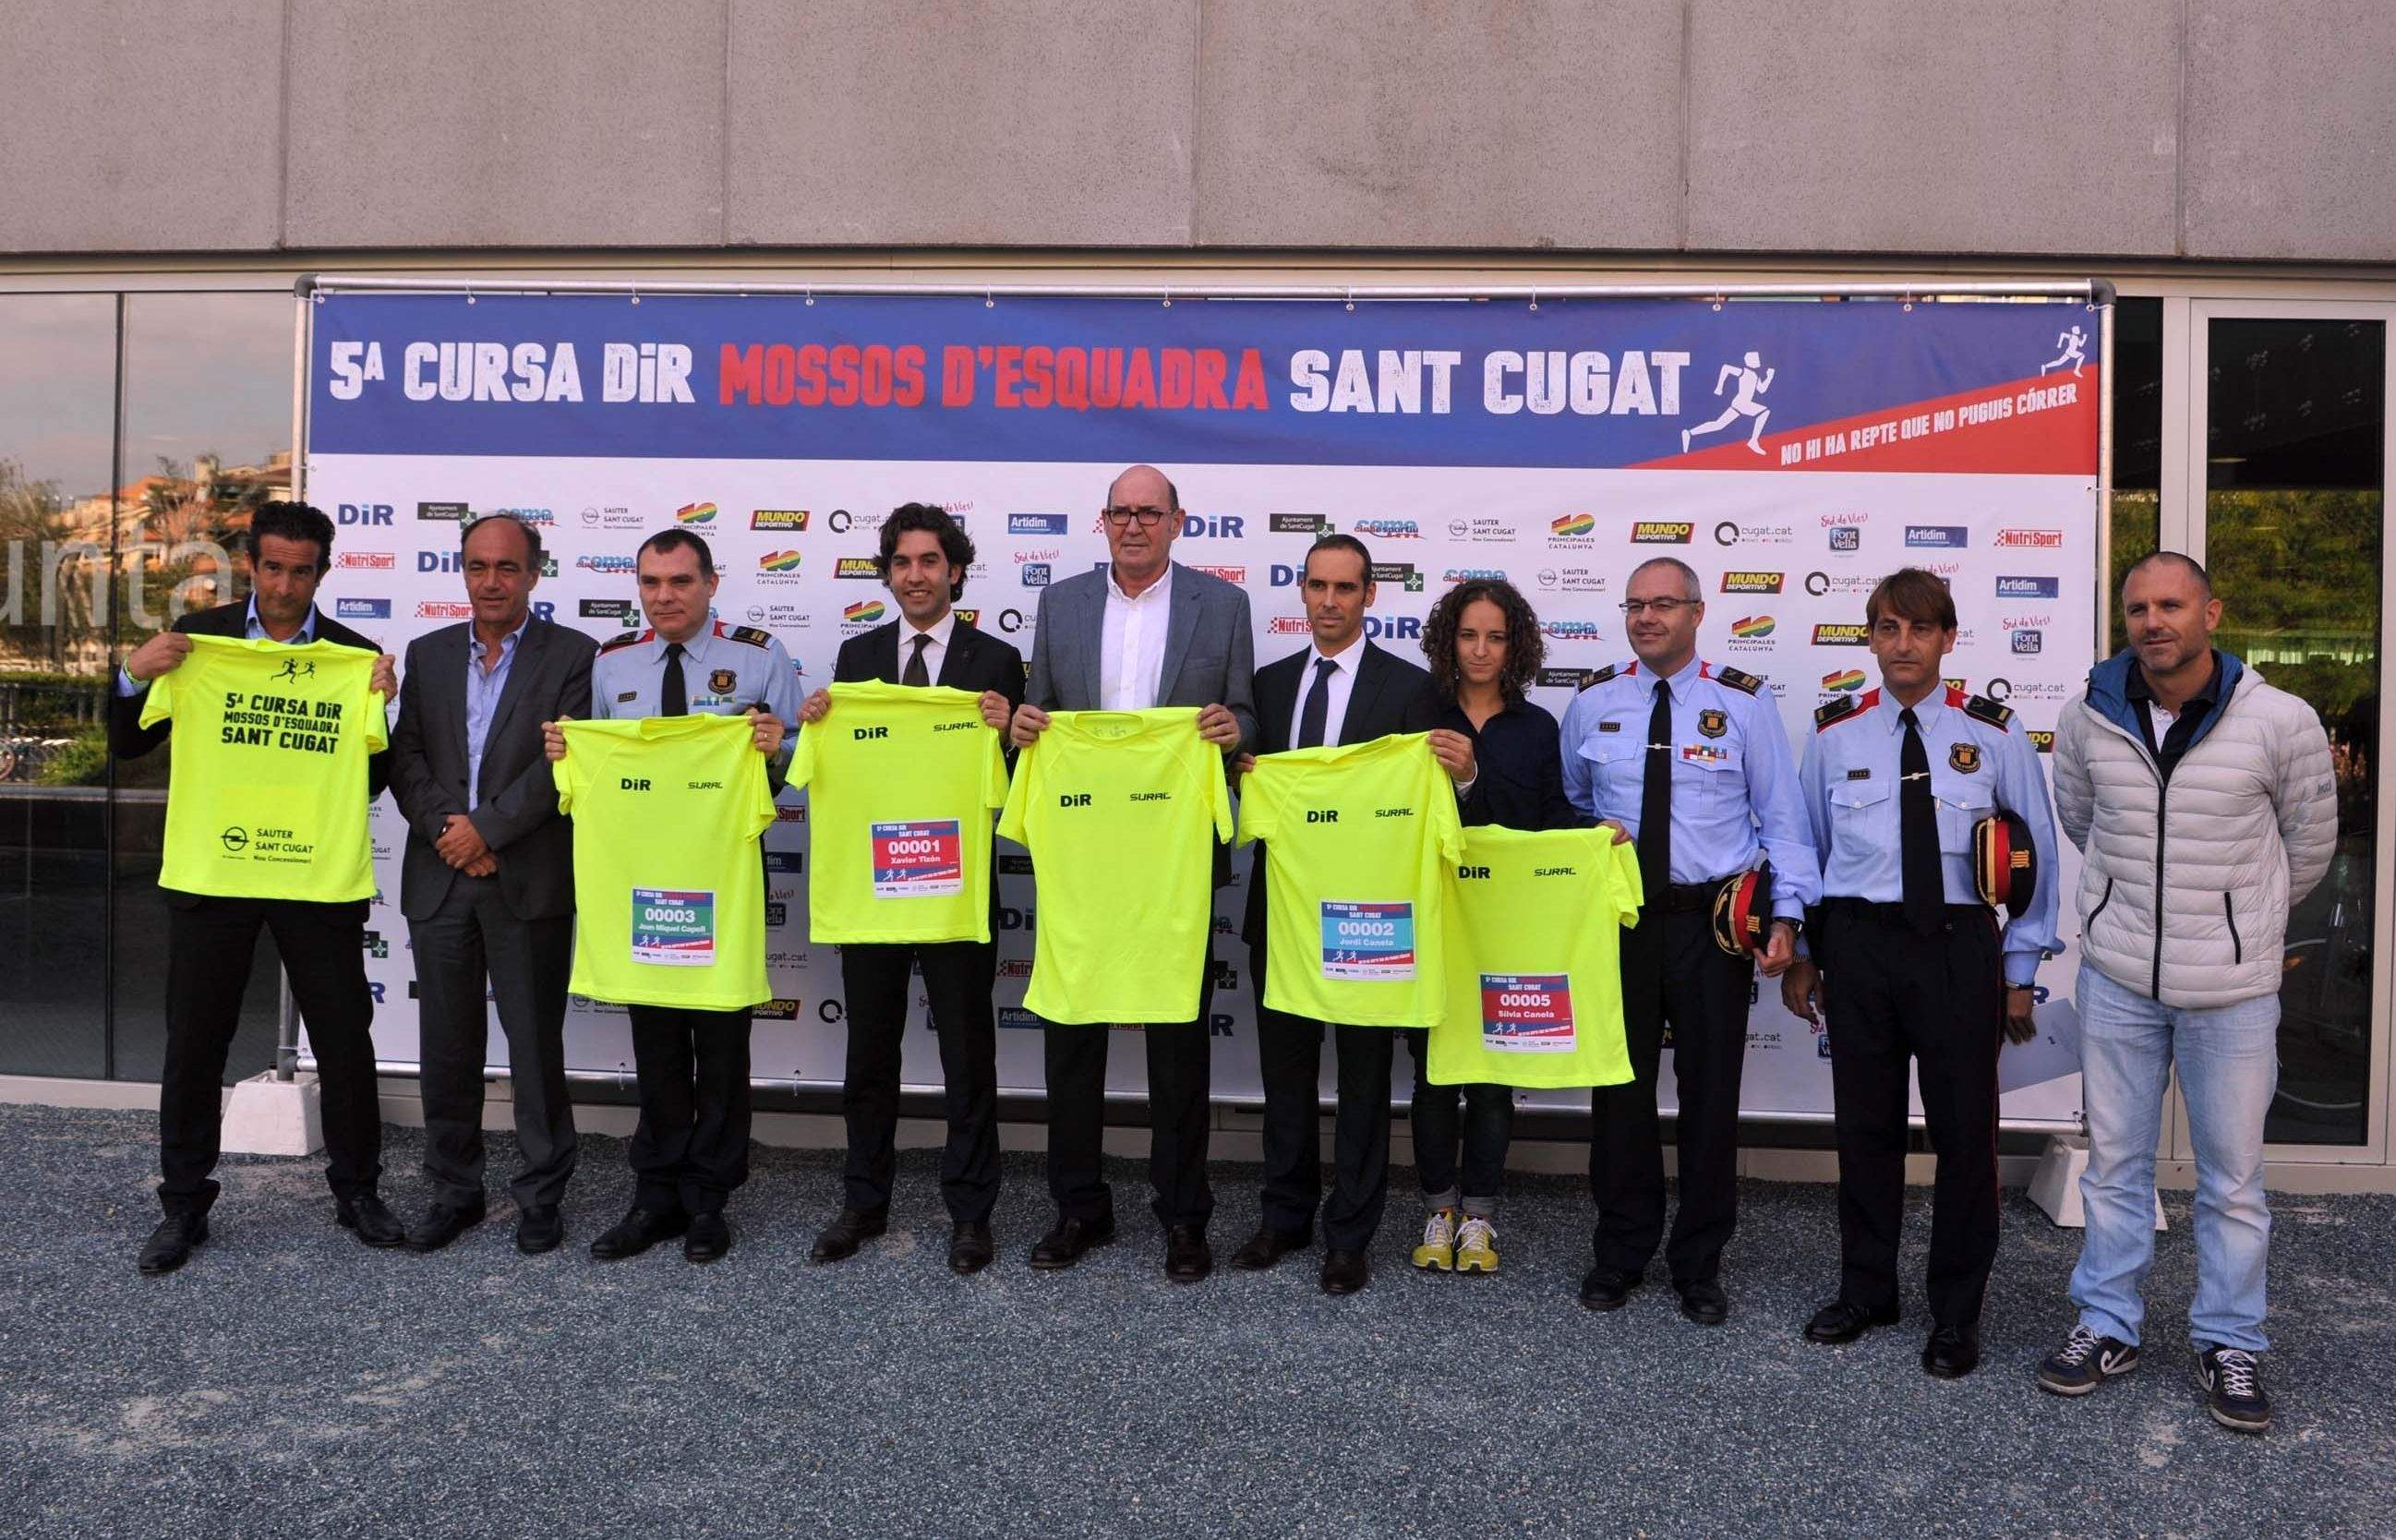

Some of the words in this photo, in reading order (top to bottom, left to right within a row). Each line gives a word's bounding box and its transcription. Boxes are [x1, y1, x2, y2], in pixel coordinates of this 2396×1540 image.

[403, 342, 584, 403] CURSA
[602, 343, 695, 403] DiR
[719, 343, 924, 406] MOSSOS
[942, 345, 1269, 413] D'ESQUADRA
[1290, 350, 1461, 414] SANT
[1484, 350, 1690, 415] CUGAT
[1781, 442, 1801, 465] NO
[1806, 438, 1821, 460] HI
[1825, 433, 1847, 456] HA
[1850, 422, 1896, 451] REPTE
[1901, 415, 1930, 439] QUE
[1934, 410, 1954, 432] NO
[1958, 398, 2012, 427] PUGUIS
[2017, 383, 2077, 414] CÓRRER
[338, 503, 393, 525] DiR
[756, 511, 805, 523] MUNDO
[1011, 517, 1047, 528] Artidim
[1183, 516, 1244, 537] DiR
[1638, 524, 1689, 535] MUNDO
[1741, 525, 1792, 536] cugat.cat
[1833, 530, 1856, 539] Font
[1908, 530, 1945, 541] Artidim
[1832, 539, 1857, 548] Vella
[1025, 565, 1048, 574] Font
[1270, 564, 1304, 586] Di
[1025, 575, 1048, 584] Vella
[1728, 573, 1779, 584] MUNDO
[1999, 580, 2037, 591] Artidim
[339, 600, 373, 612] Artidim
[2016, 632, 2039, 642] Font
[2015, 642, 2039, 652] Vella
[2014, 682, 2065, 694] cugat.cat
[250, 694, 308, 716] CURSA
[223, 711, 270, 727] MOSSOS
[273, 714, 340, 734] D'ESQUADRA
[853, 727, 888, 740] DiR
[222, 727, 273, 747] SANT
[280, 733, 338, 754] CUGAT
[620, 778, 651, 791] DiR
[1060, 794, 1091, 807] DiR
[1306, 810, 1339, 824] DiR
[257, 828, 293, 839] SAUTER
[255, 842, 280, 851] SANT
[283, 844, 313, 854] CUGAT
[888, 839, 940, 855] 00001
[1458, 866, 1491, 879] DiR
[644, 908, 695, 923] 00003
[999, 908, 1034, 931] Di
[1338, 921, 1395, 936] 00002
[766, 953, 807, 963] ugat.cat
[1499, 993, 1551, 1007] 00005
